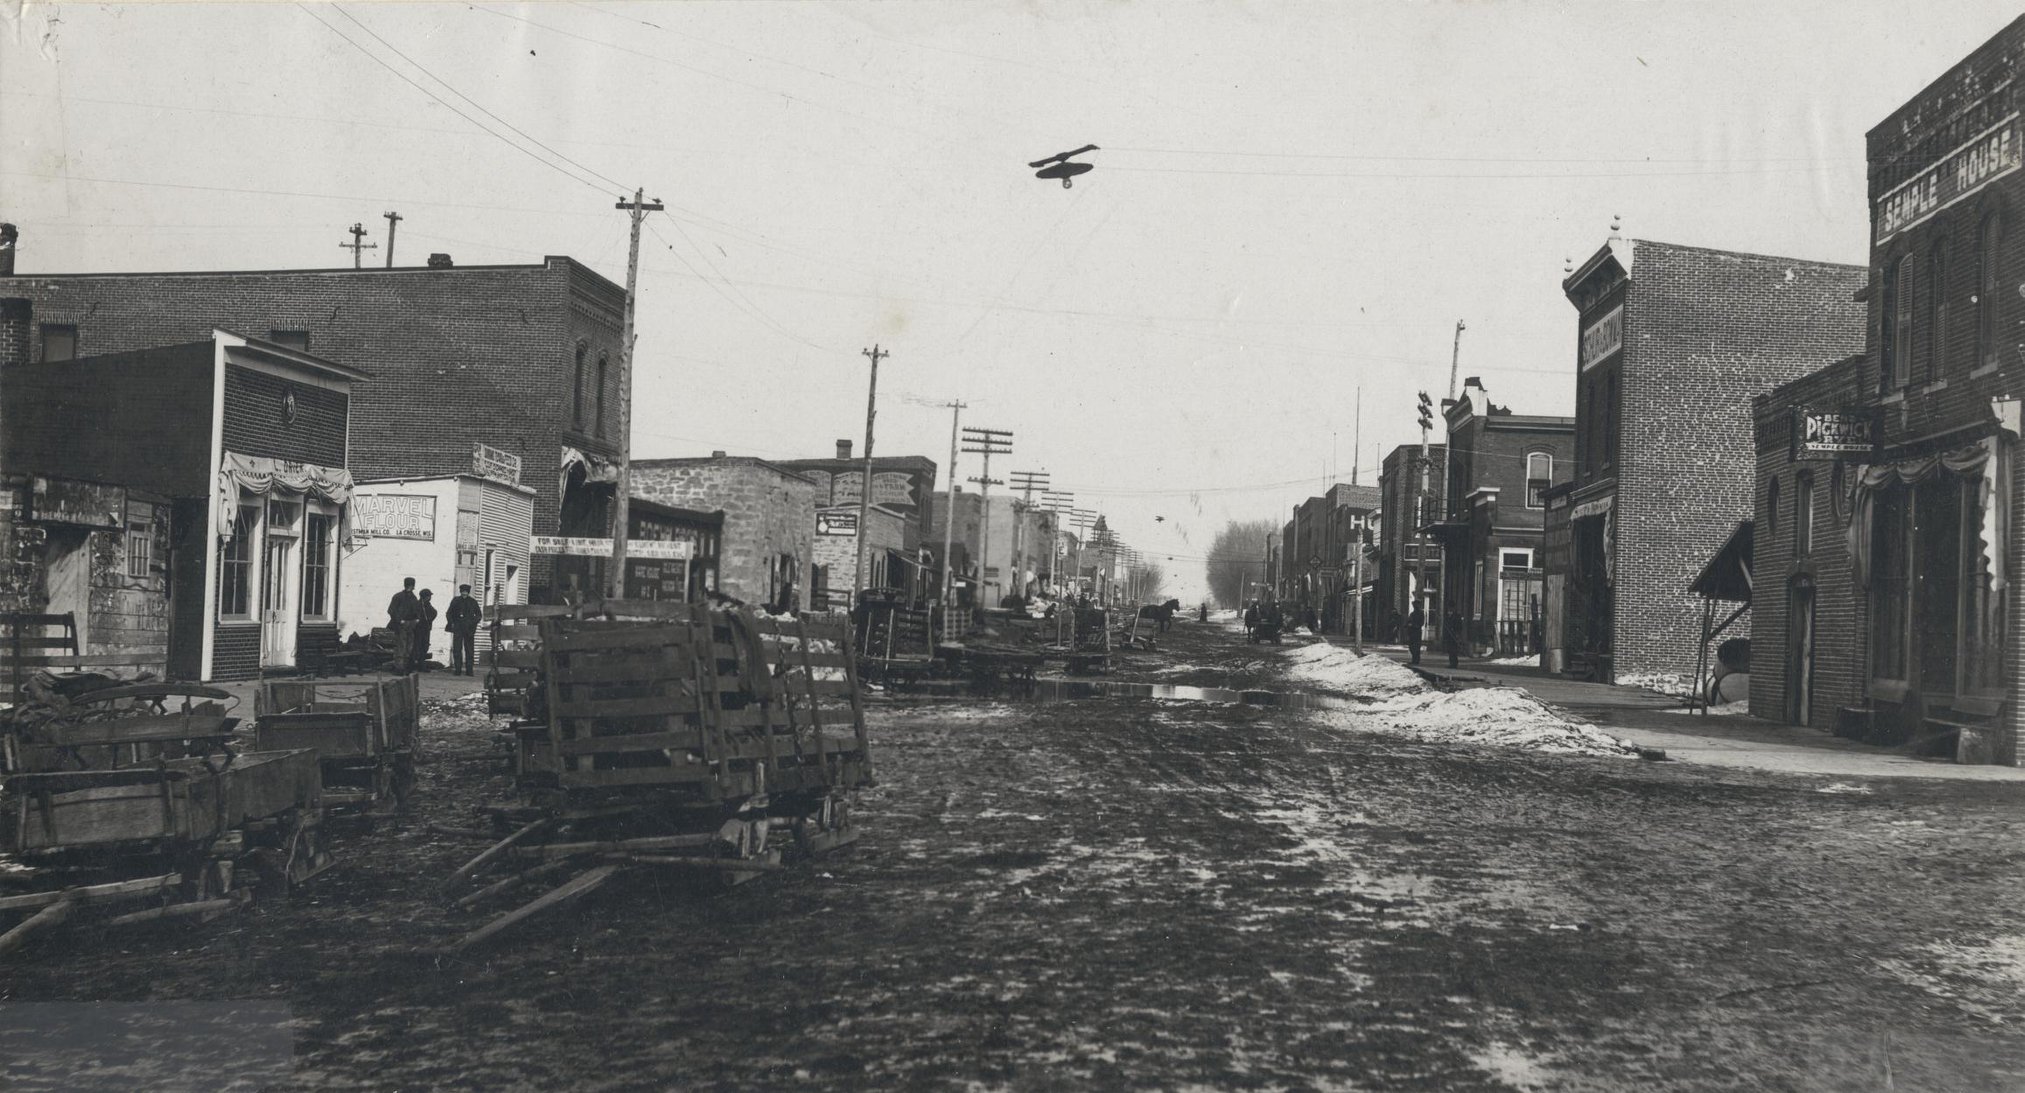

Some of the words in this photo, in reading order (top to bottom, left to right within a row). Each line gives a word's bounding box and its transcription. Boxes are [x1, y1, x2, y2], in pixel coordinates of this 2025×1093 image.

[1885, 173, 1938, 232] SEMPLE
[1957, 128, 2011, 192] HOUSE
[352, 496, 434, 519] MARVEL
[363, 513, 421, 530] FLOUR
[537, 537, 551, 545] FOR
[553, 538, 569, 546] SALE
